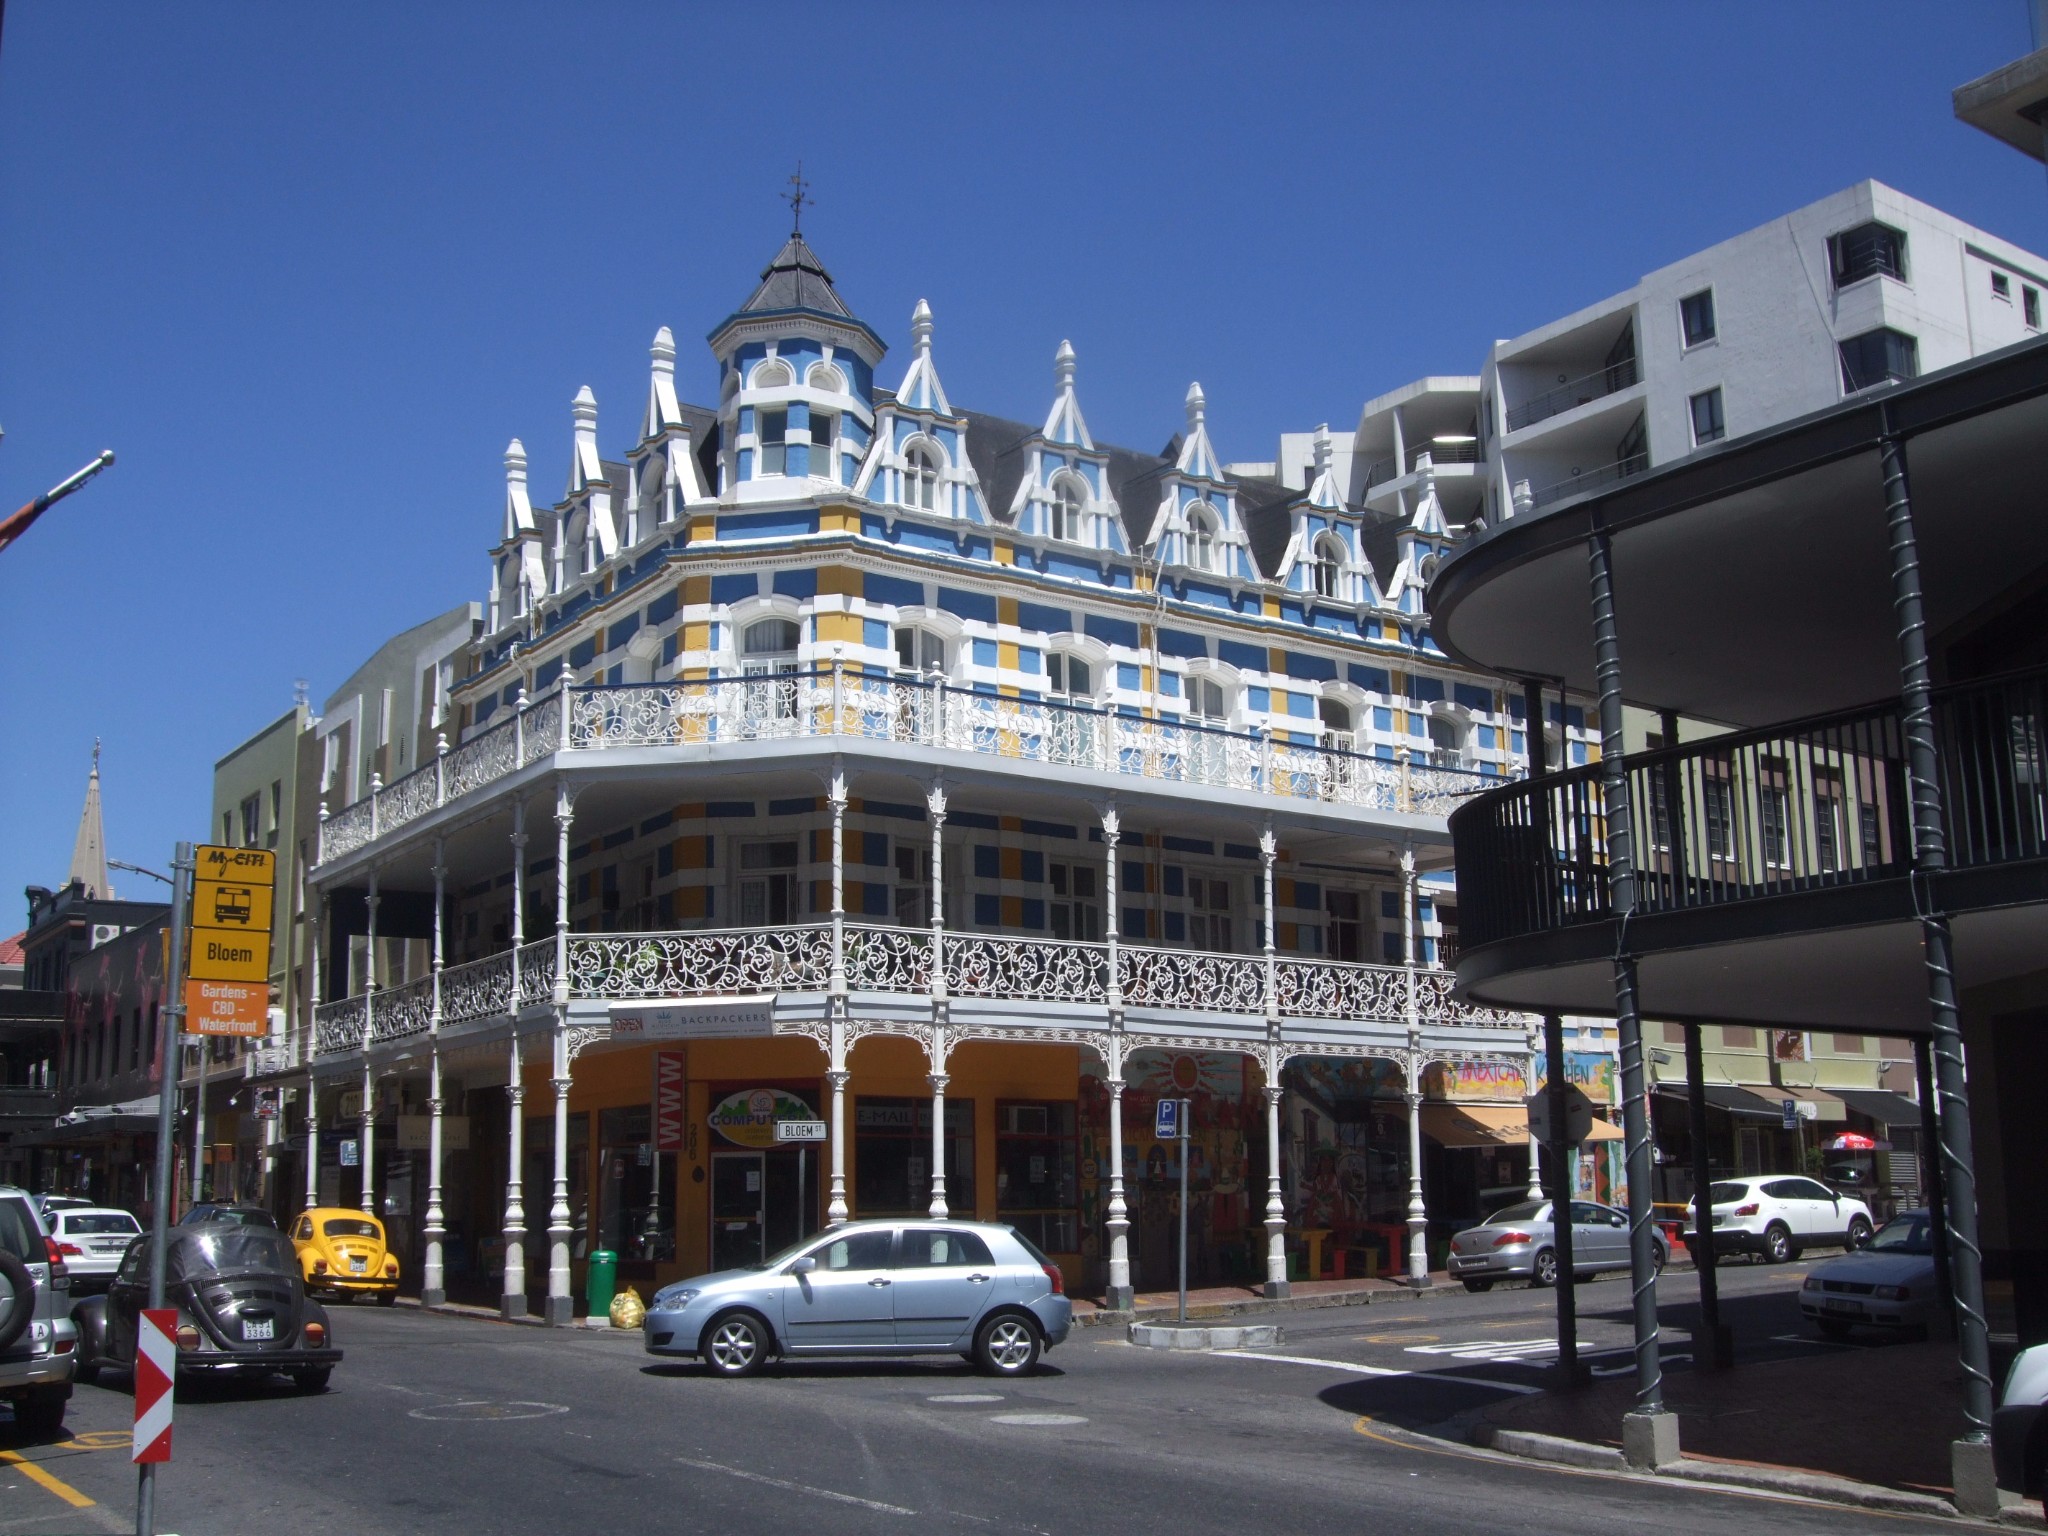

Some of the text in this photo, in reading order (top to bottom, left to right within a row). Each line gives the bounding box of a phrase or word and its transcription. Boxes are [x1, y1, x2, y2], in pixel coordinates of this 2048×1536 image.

[207, 943, 252, 962] Bloem
[202, 984, 247, 998] Gardens
[212, 1001, 235, 1014] CBD
[199, 1017, 256, 1032] Waterfront
[614, 1017, 643, 1032] OPEN
[681, 1013, 767, 1025] BACKPACKERS
[1535, 1061, 1590, 1086] KHEN
[659, 1056, 681, 1145] WWW
[857, 1110, 912, 1124] E-MAIL
[1162, 1103, 1173, 1118] P
[785, 1125, 813, 1137] BLOEM
[246, 1329, 271, 1338] 3366
